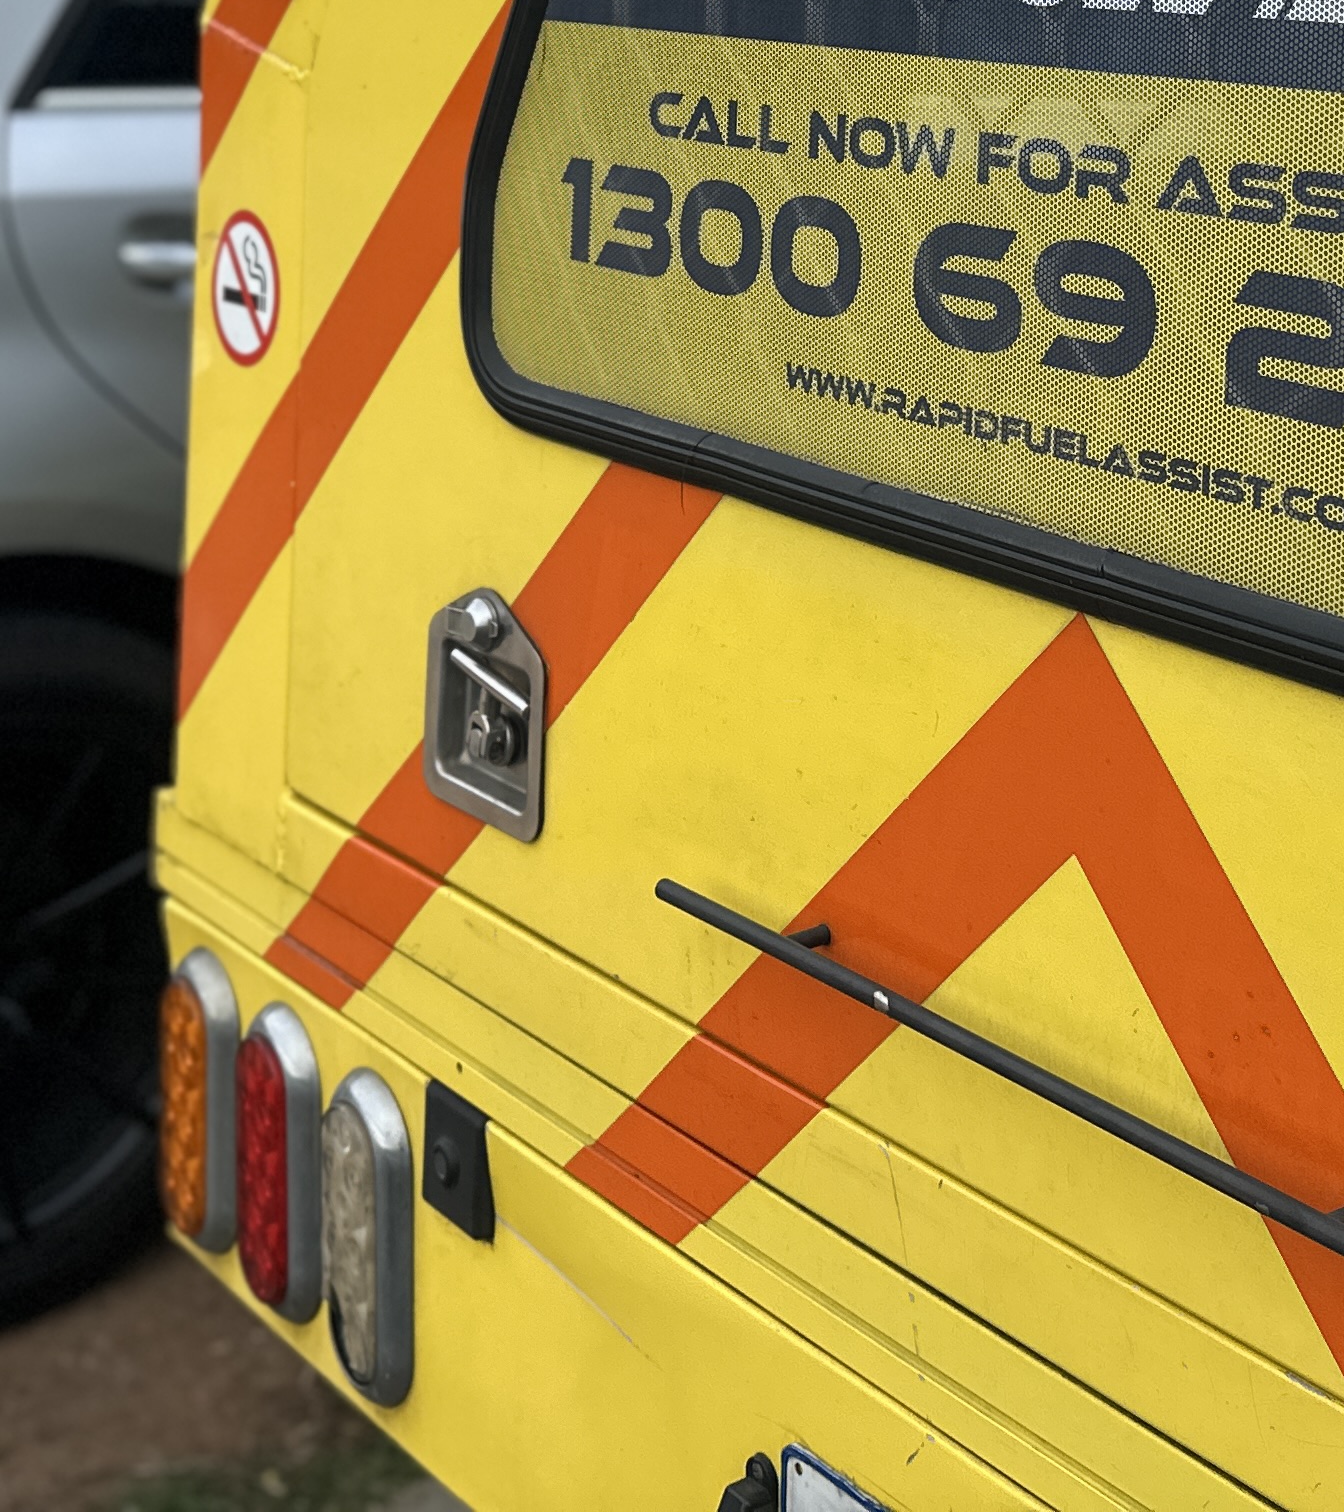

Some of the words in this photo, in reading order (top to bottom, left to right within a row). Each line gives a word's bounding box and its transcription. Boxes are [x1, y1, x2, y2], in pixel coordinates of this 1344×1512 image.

[648, 91, 790, 156] CALL
[808, 114, 955, 182] NOW
[976, 131, 1132, 205] FOR
[560, 156, 861, 319] 1300
[912, 221, 1160, 380] 69
